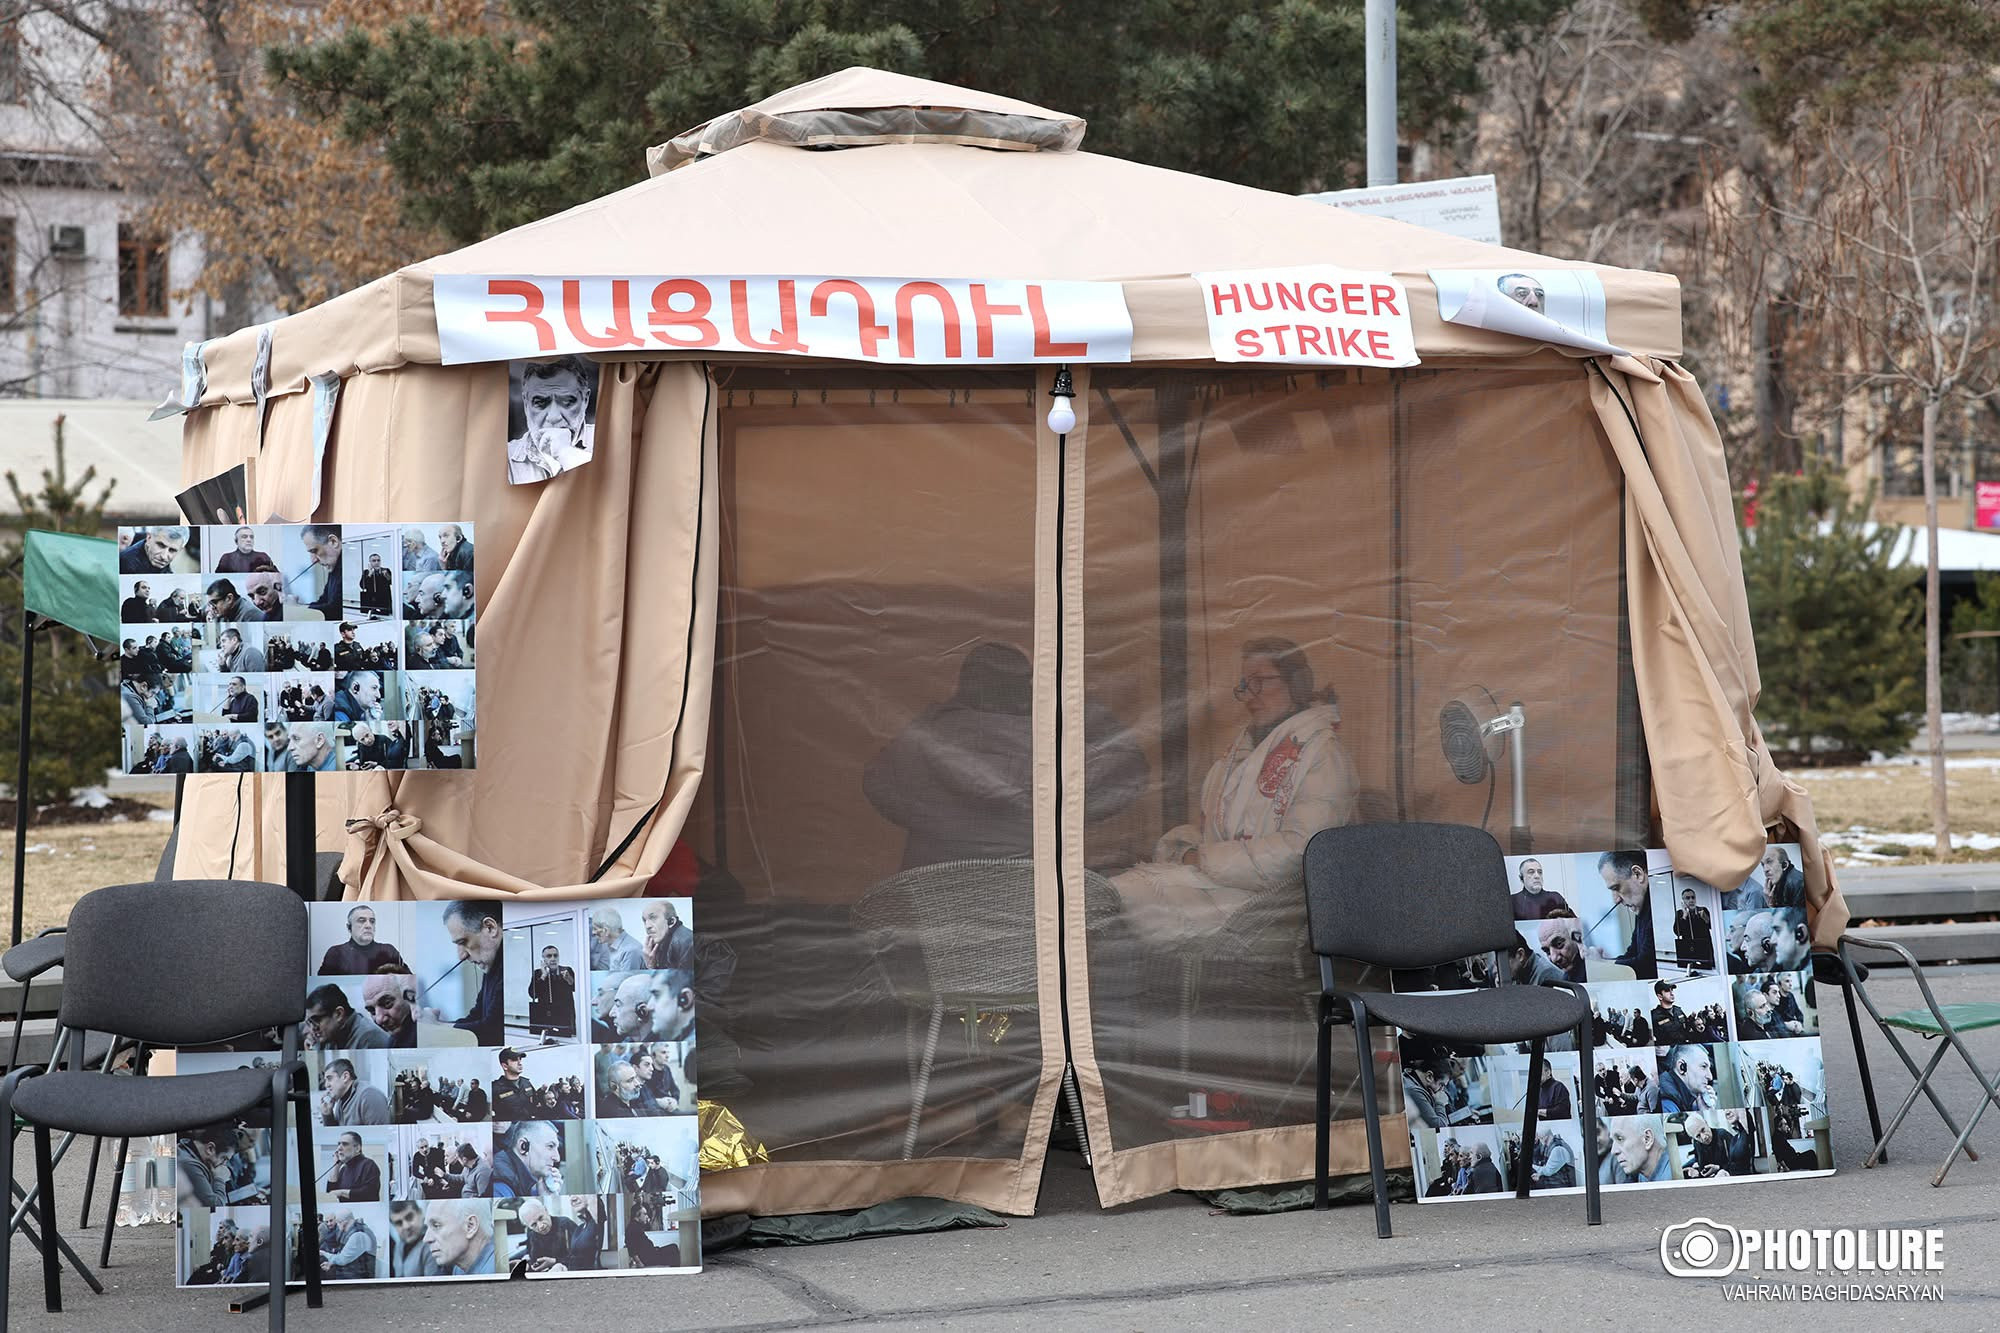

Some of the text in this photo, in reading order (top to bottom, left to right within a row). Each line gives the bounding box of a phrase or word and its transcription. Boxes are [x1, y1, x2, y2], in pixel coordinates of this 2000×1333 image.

[1211, 282, 1400, 316] HUNGER
[486, 279, 1087, 358] ՀԱՑԱԴՈՒԼ
[1235, 325, 1394, 360] STRIKE
